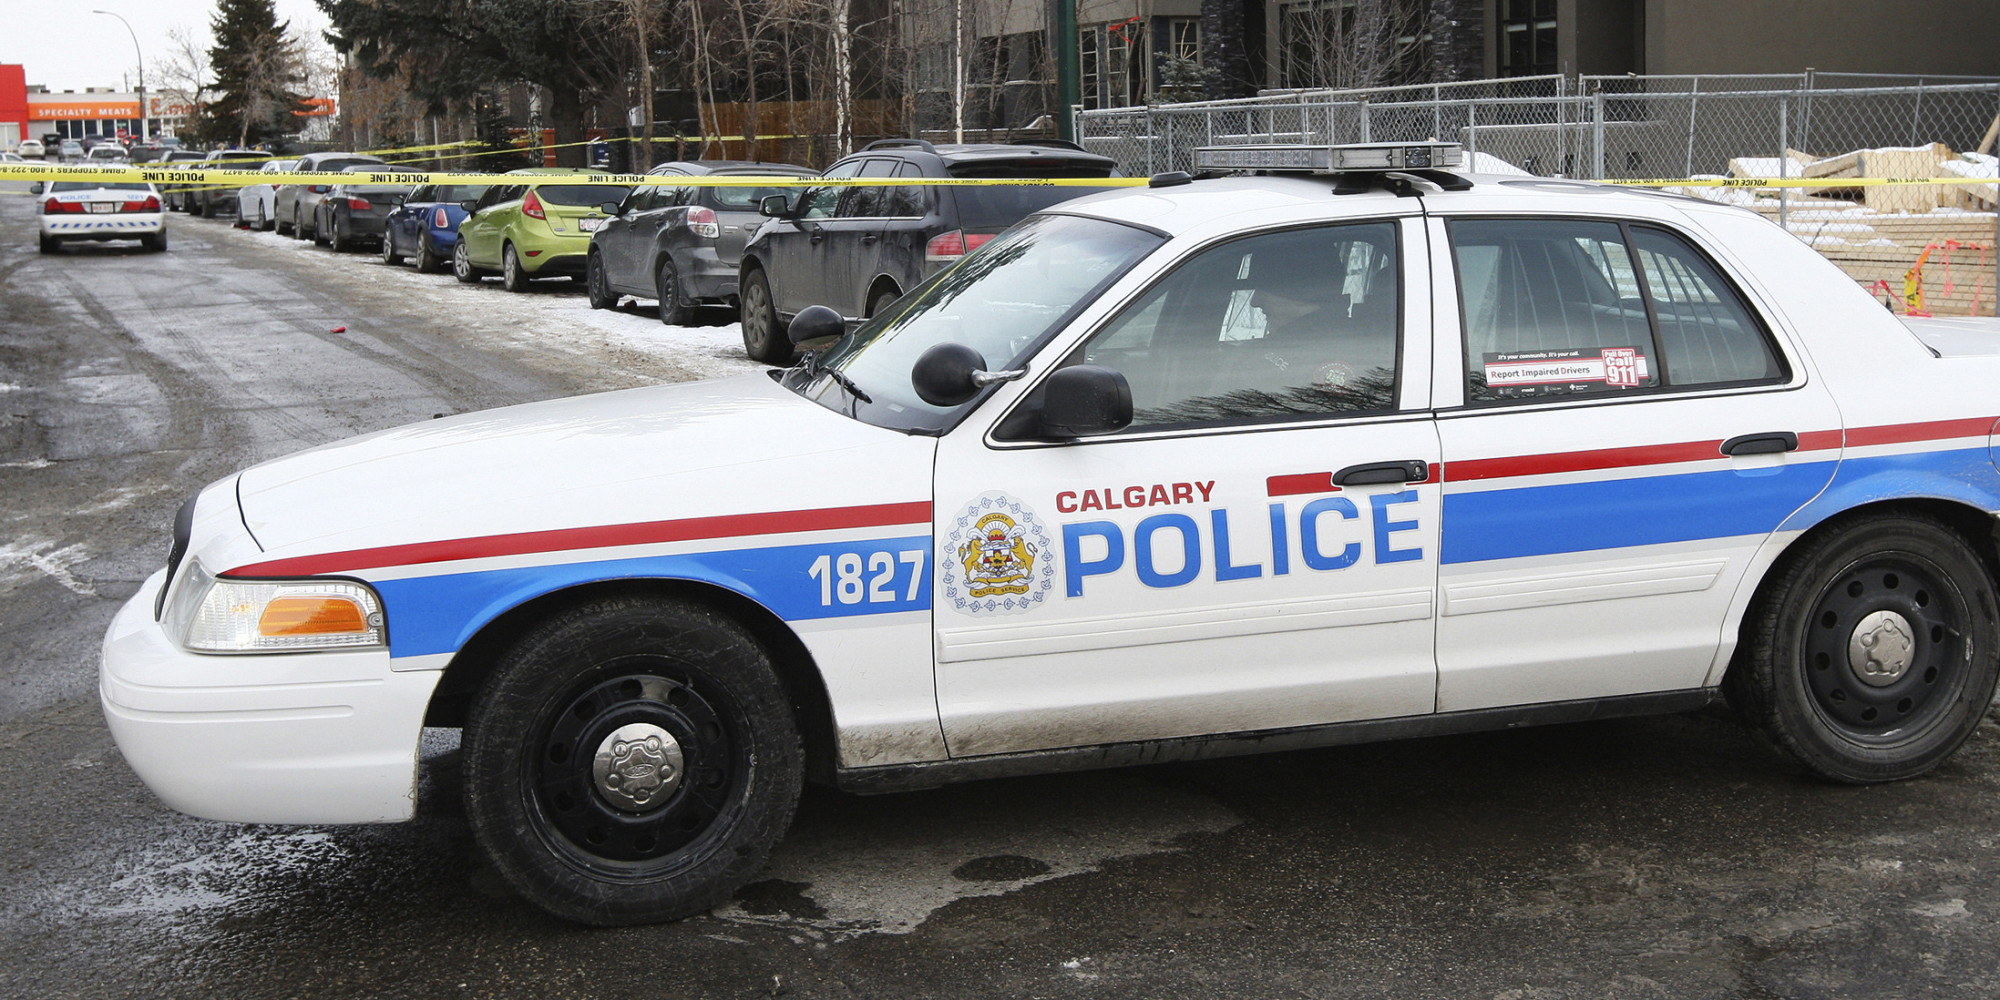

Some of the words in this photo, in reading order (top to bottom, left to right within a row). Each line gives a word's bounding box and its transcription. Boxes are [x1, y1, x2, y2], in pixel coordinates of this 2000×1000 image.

[38, 108, 91, 116] SPECIALTY
[98, 108, 132, 116] MEATS
[142, 172, 165, 181] LINE
[168, 173, 205, 182] POLICE
[370, 173, 392, 182] LINE
[395, 174, 430, 183] POLICE
[588, 175, 609, 183] LINE
[611, 175, 645, 183] POLICE
[1722, 179, 1739, 187] LINE
[1740, 179, 1768, 187] POLICE
[1605, 356, 1634, 367] Call
[1491, 369, 1520, 379] Report
[1522, 367, 1559, 379] Impaired
[1561, 366, 1590, 375] Drivers
[1607, 366, 1636, 384] 911
[1056, 480, 1215, 513] CALGARY
[981, 514, 1008, 524] CALGARY
[1062, 489, 1423, 598] POLICE
[808, 549, 925, 606] 1827
[975, 587, 997, 596] POLICE
